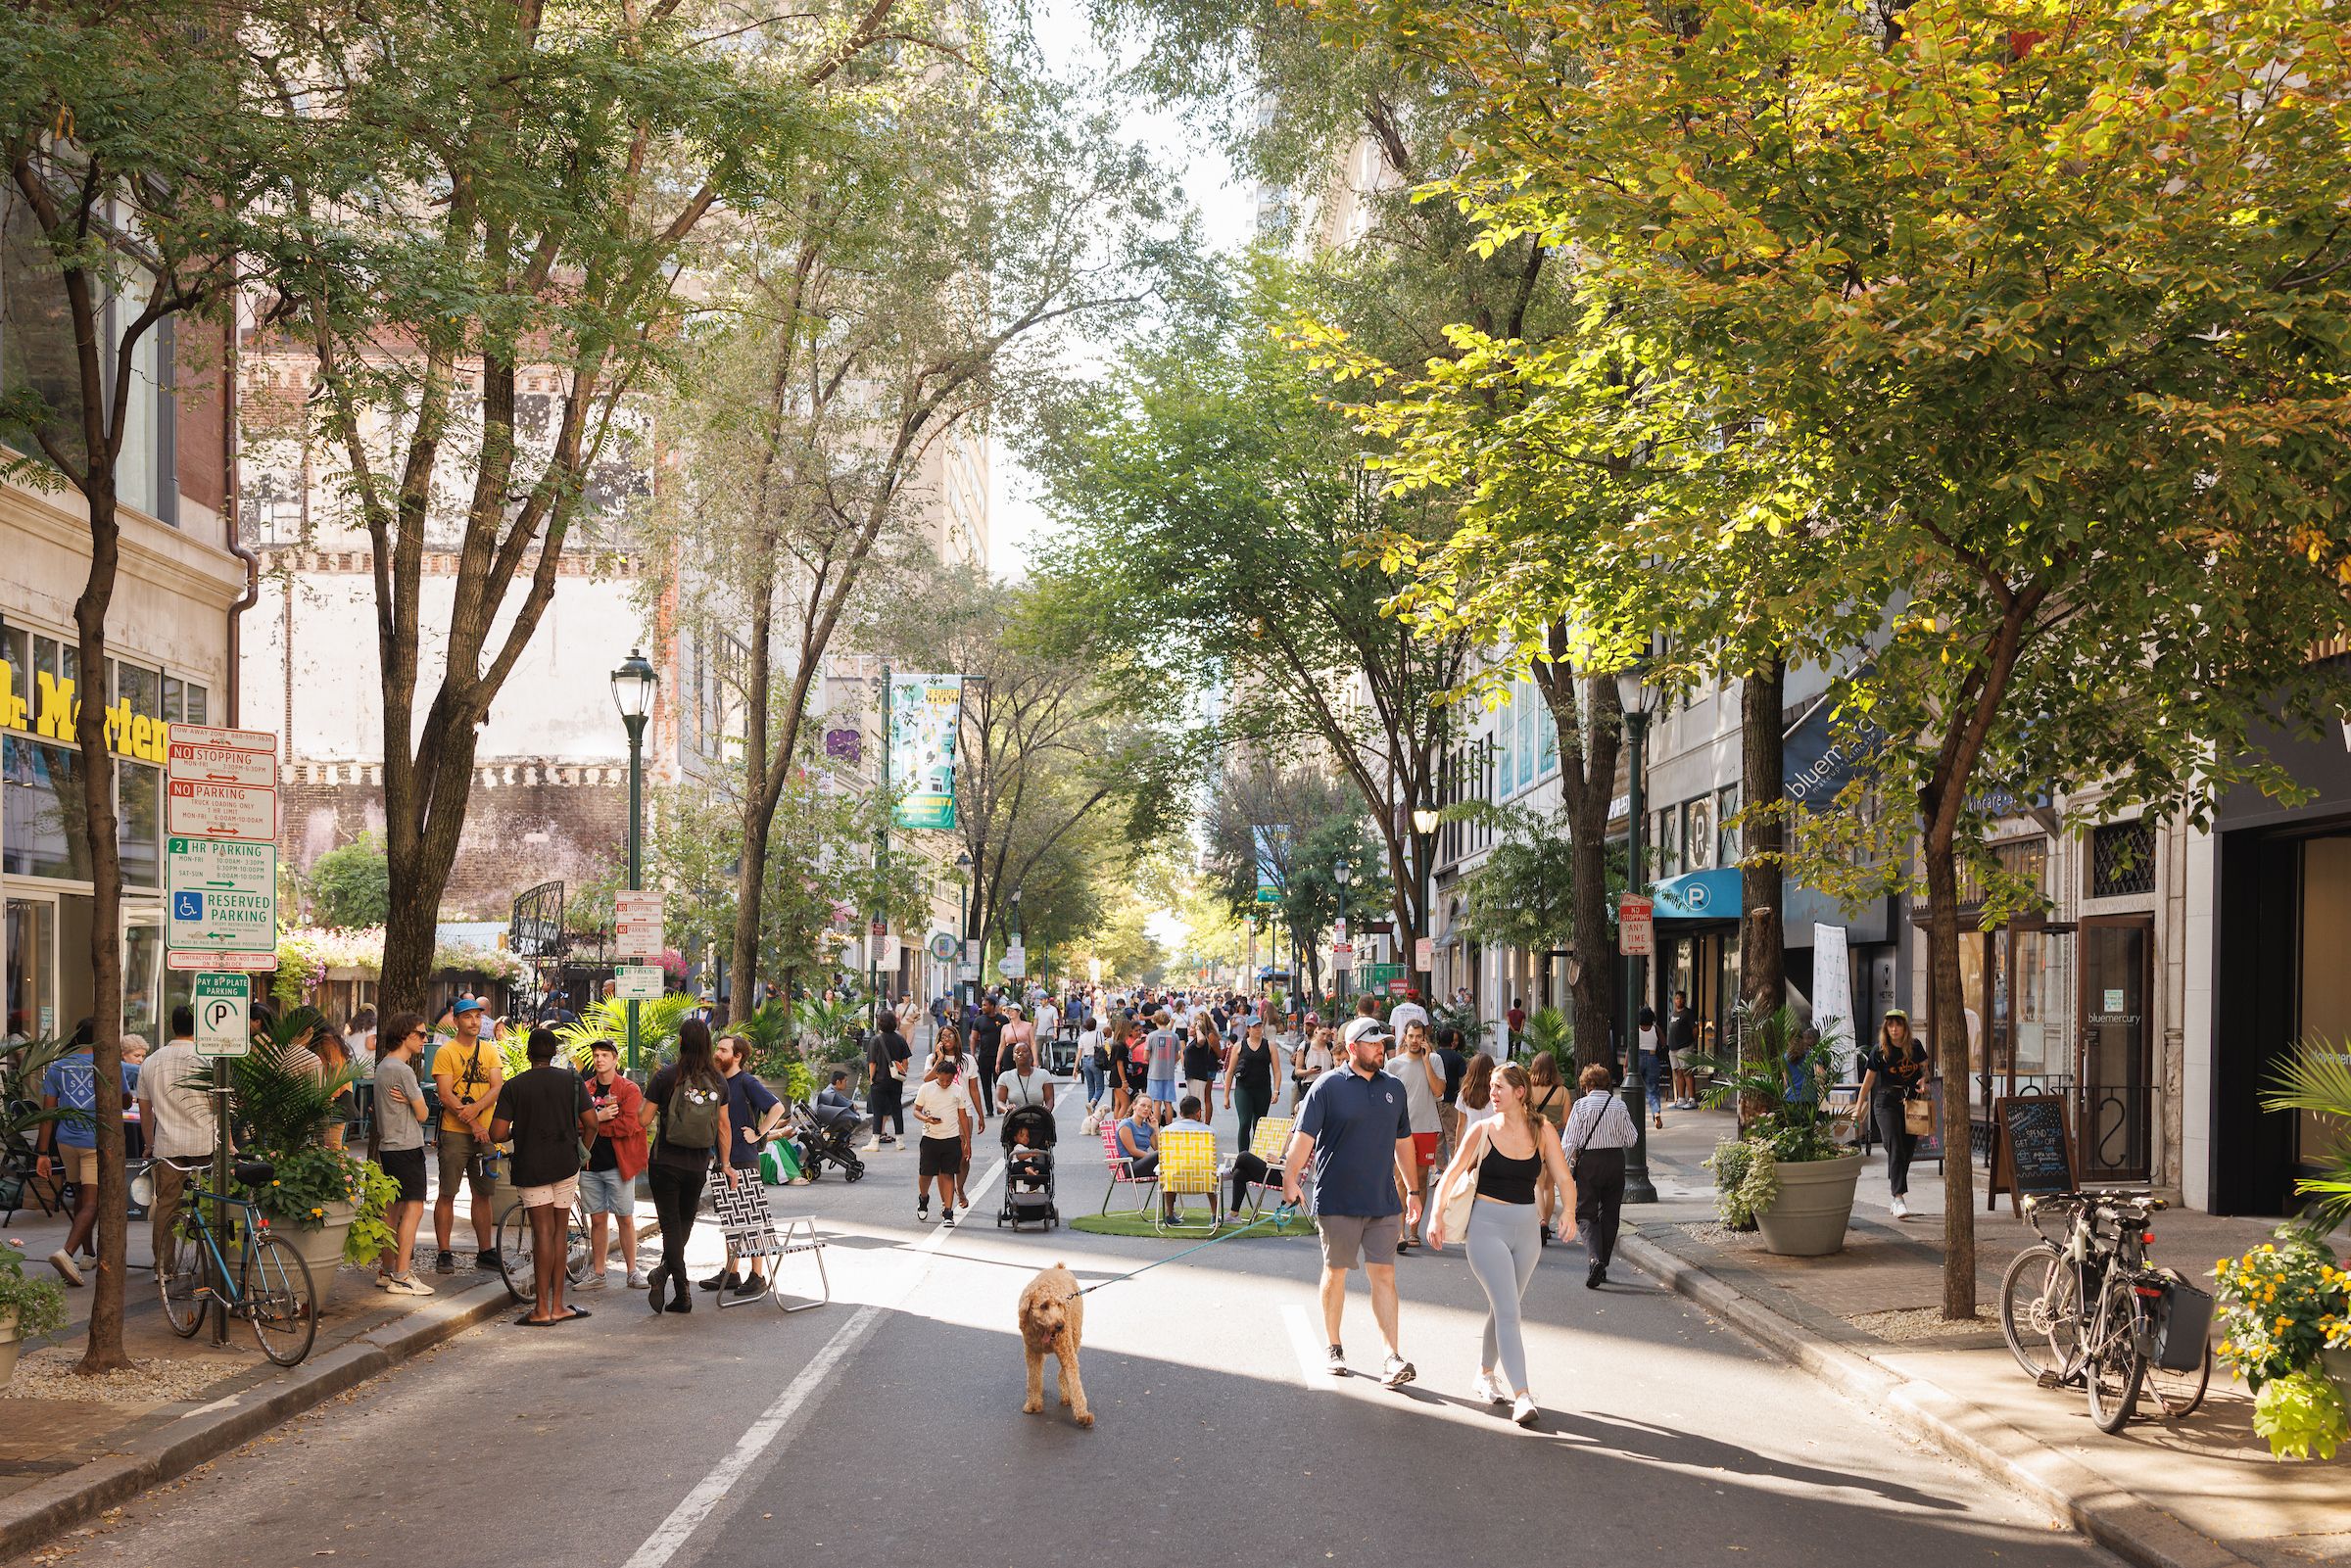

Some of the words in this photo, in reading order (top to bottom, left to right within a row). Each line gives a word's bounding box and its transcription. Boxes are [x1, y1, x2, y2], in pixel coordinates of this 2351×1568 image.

[37, 671, 168, 764] Mrten
[174, 746, 191, 759] NO
[197, 750, 252, 764] STOPPING
[174, 784, 191, 796] NO
[197, 786, 245, 800] PARKING
[1966, 794, 2002, 813] kincare
[176, 841, 183, 852] 2
[192, 843, 206, 853] HR
[213, 844, 261, 857] PARKING
[208, 895, 270, 908] RESERVED
[212, 909, 266, 923] PARKING
[216, 1005, 227, 1025] P
[2087, 1012, 2141, 1025] bluemercury
[2026, 1129, 2047, 1138] SPEND
[2015, 1139, 2028, 1148] GET
